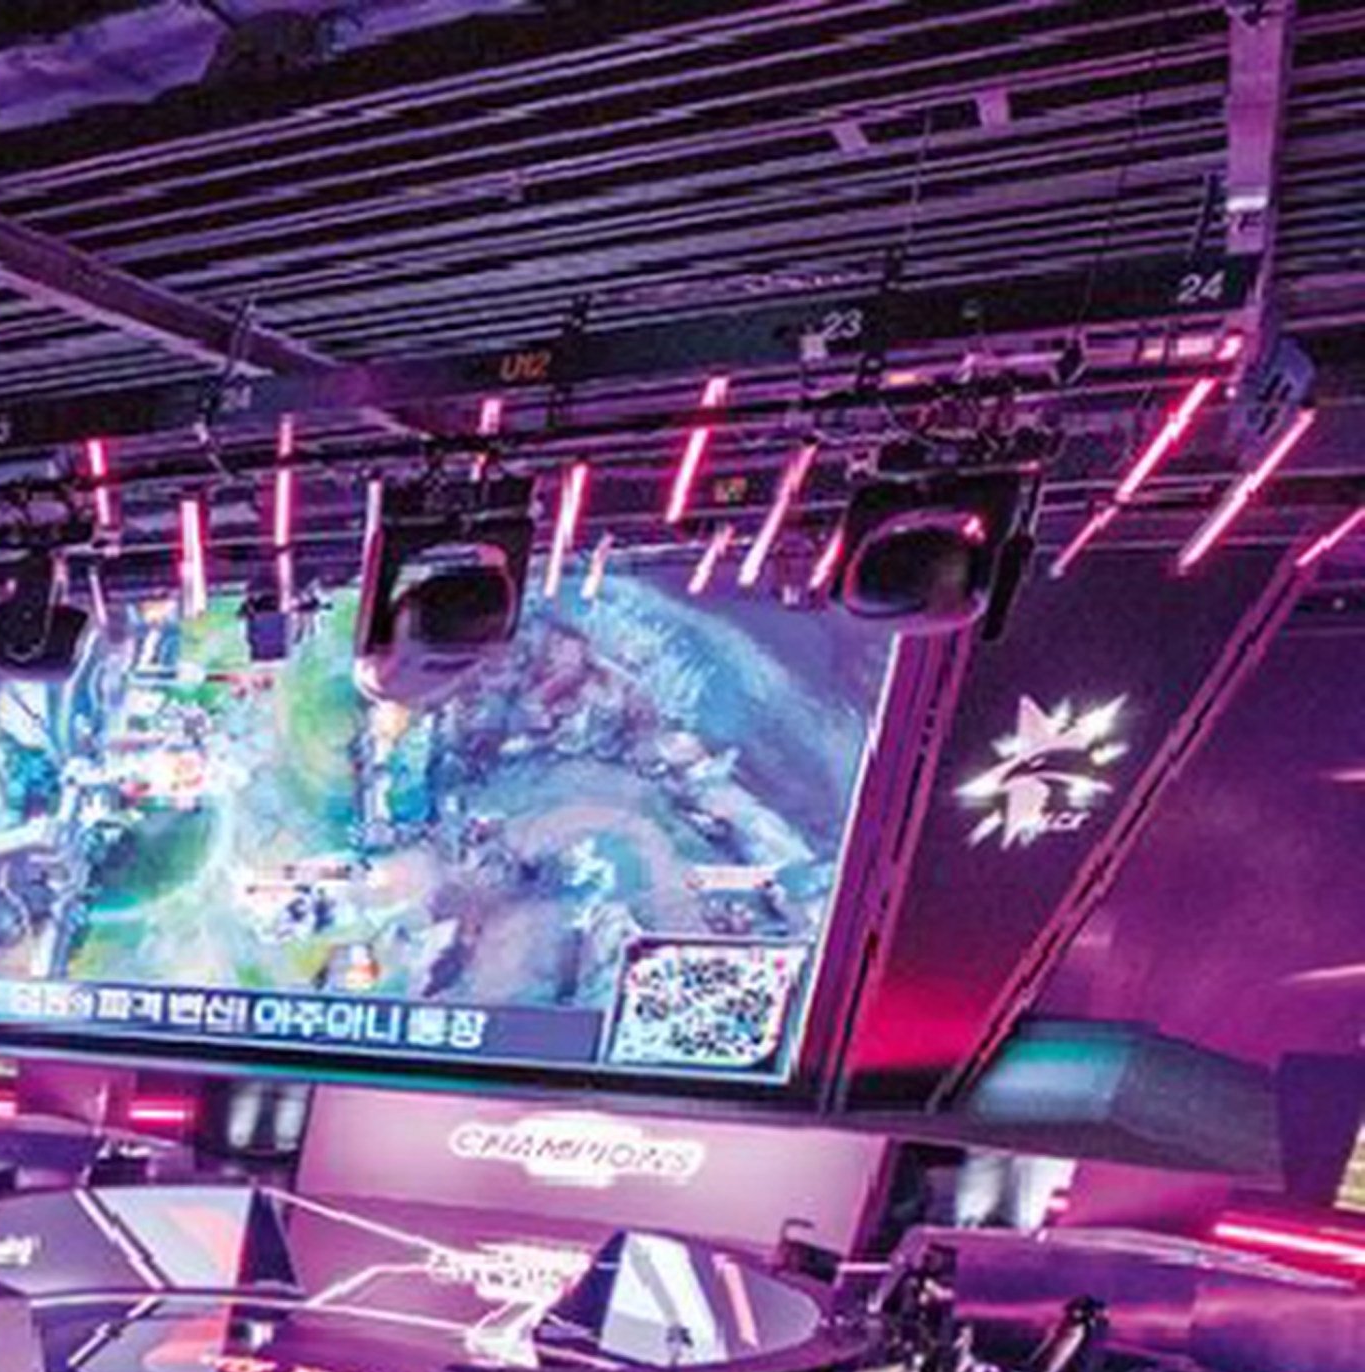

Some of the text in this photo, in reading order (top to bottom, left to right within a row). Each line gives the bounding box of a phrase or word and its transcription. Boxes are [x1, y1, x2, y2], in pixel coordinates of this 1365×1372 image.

[1177, 270, 1226, 304] 24
[821, 308, 864, 341] 23
[98, 987, 162, 1024] 파격
[455, 1126, 690, 1173] CHAMPIONS
